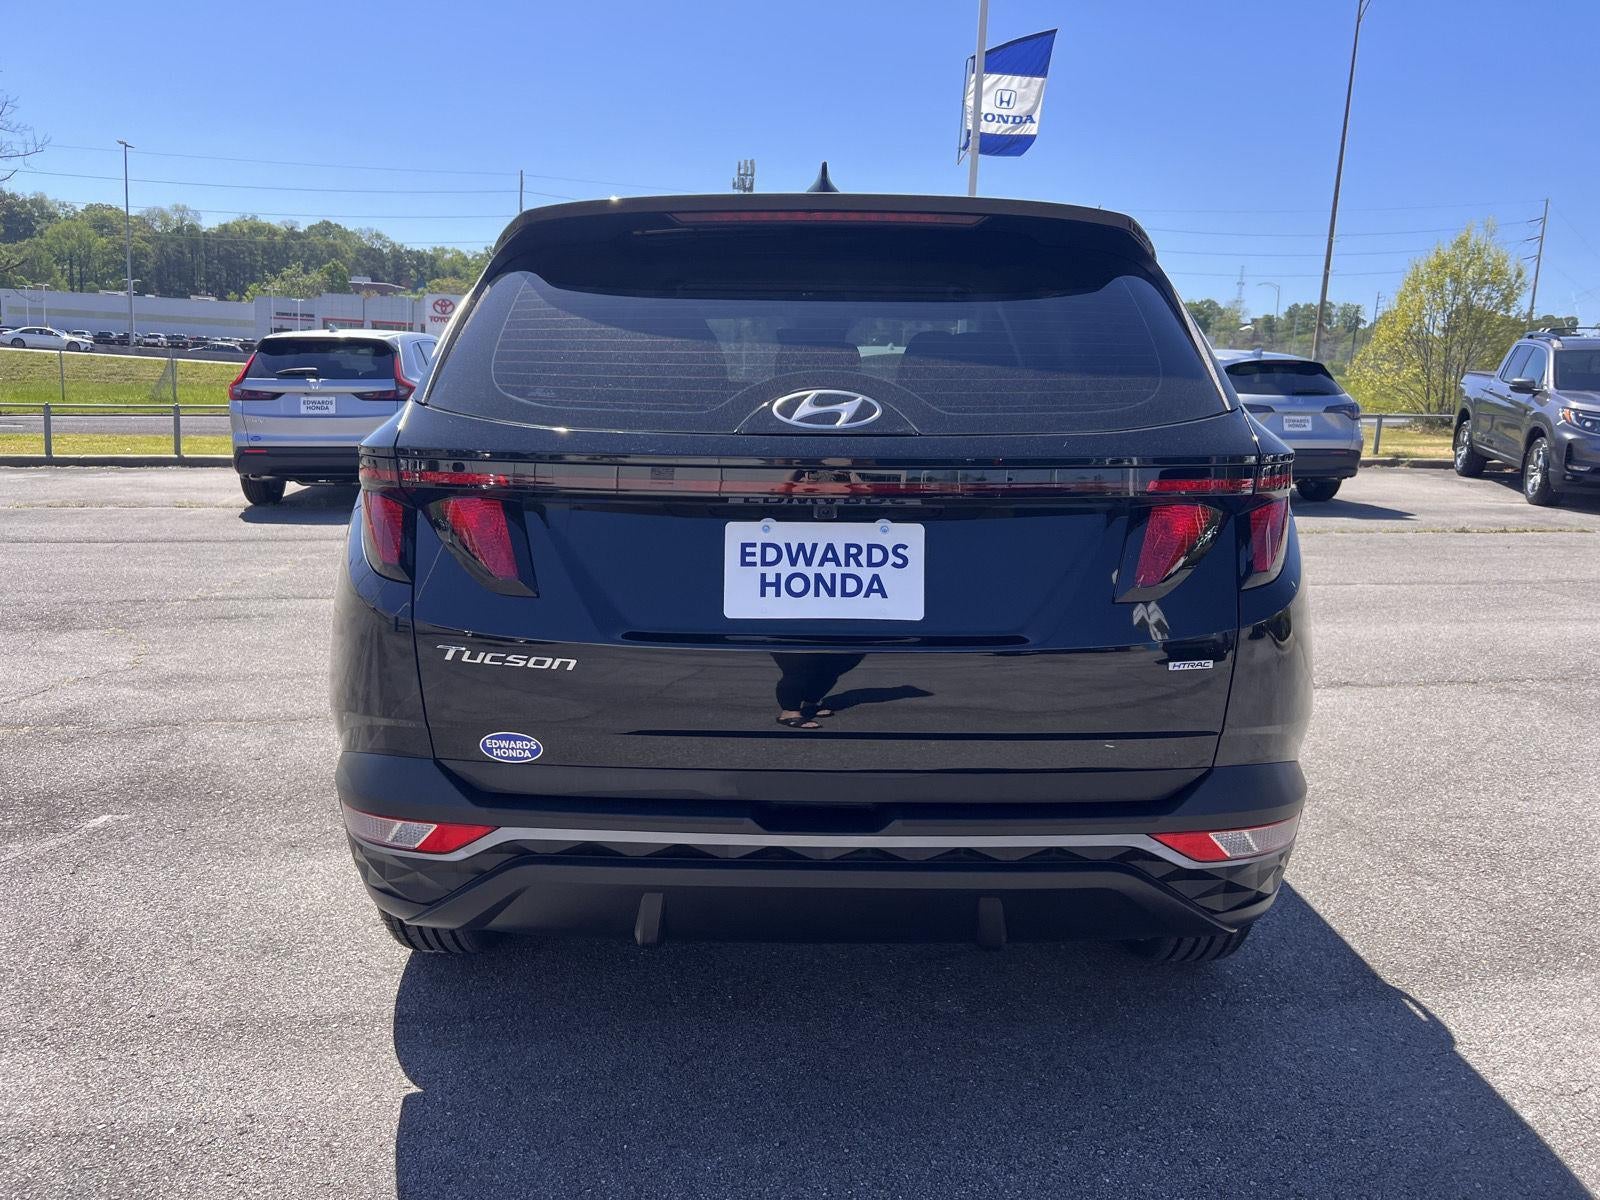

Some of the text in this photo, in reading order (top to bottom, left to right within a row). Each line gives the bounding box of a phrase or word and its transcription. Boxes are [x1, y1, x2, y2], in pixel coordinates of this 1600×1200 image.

[981, 112, 1036, 124] ONDA
[429, 315, 449, 324] TOYO
[740, 542, 909, 569] EDWARDS
[759, 572, 888, 599] HONDA
[1172, 661, 1211, 670] HTRAC
[485, 739, 537, 751] EDWARDS
[492, 748, 532, 758] HONDA
